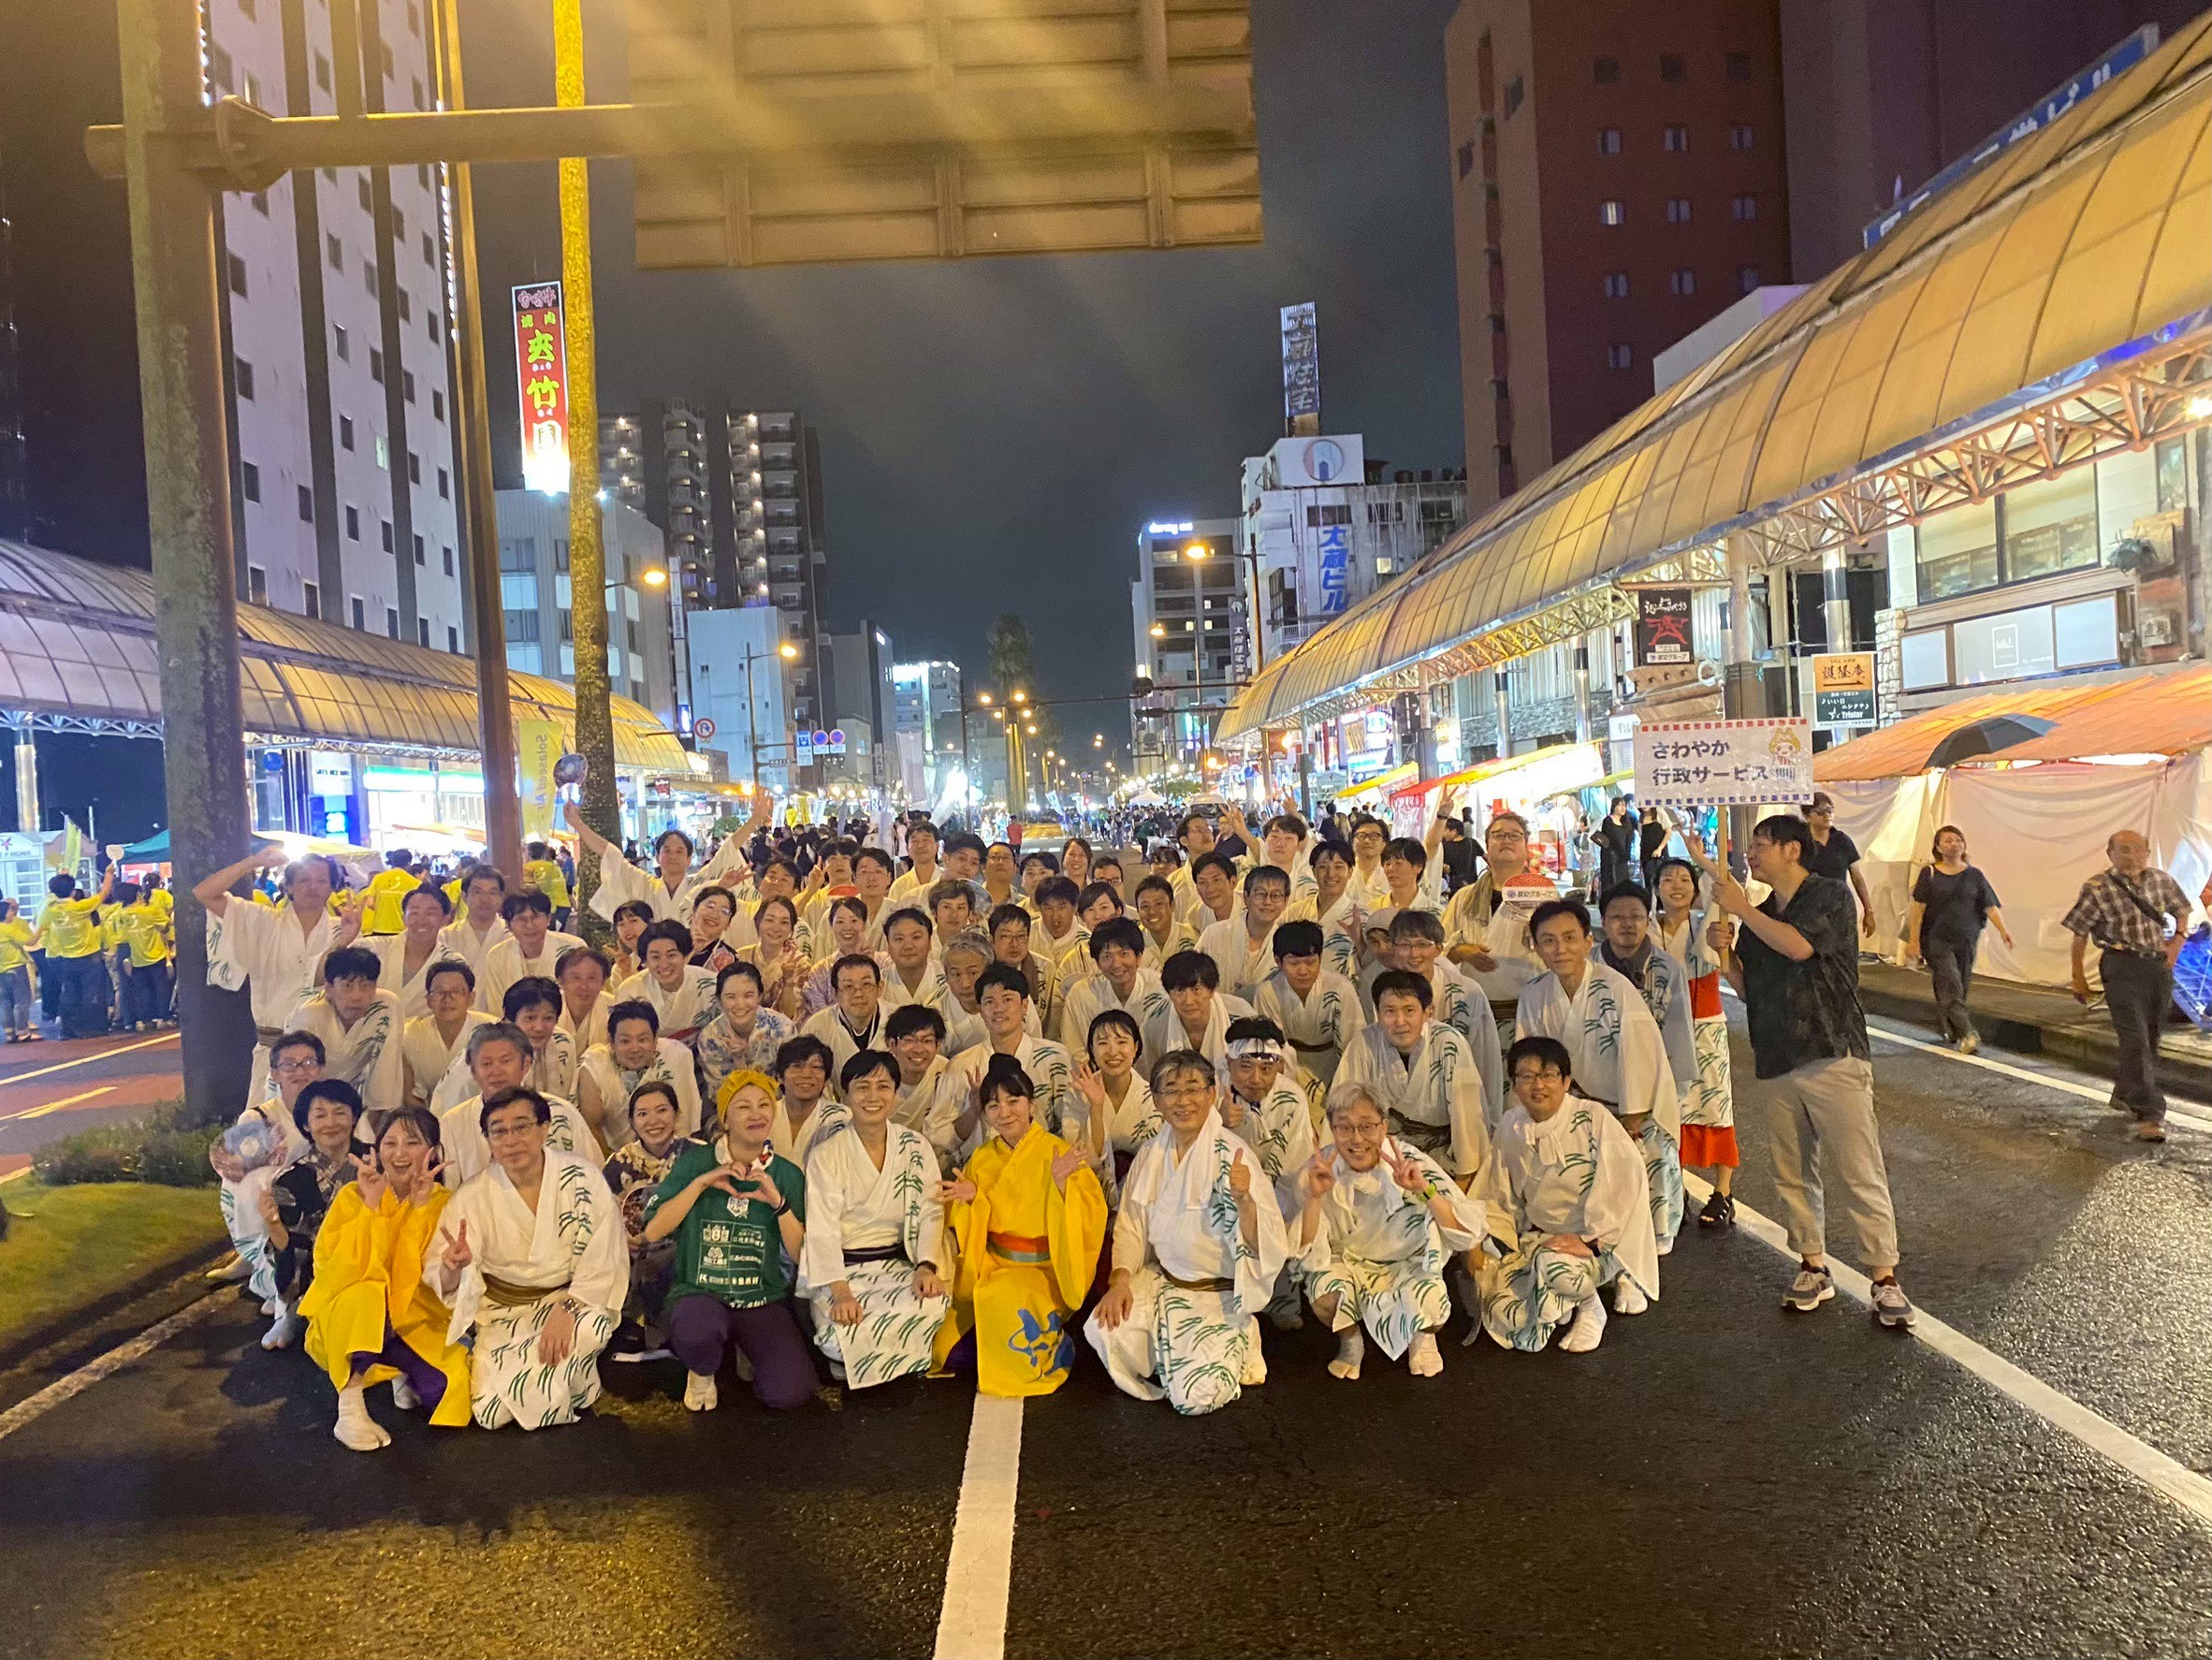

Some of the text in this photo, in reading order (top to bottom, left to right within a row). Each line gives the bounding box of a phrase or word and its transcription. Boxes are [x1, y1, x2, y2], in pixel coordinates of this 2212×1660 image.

[1318, 526, 1349, 611] 大蔵ビル
[1652, 739, 1730, 760] さわやか
[1652, 764, 1768, 786] 行政サービス
